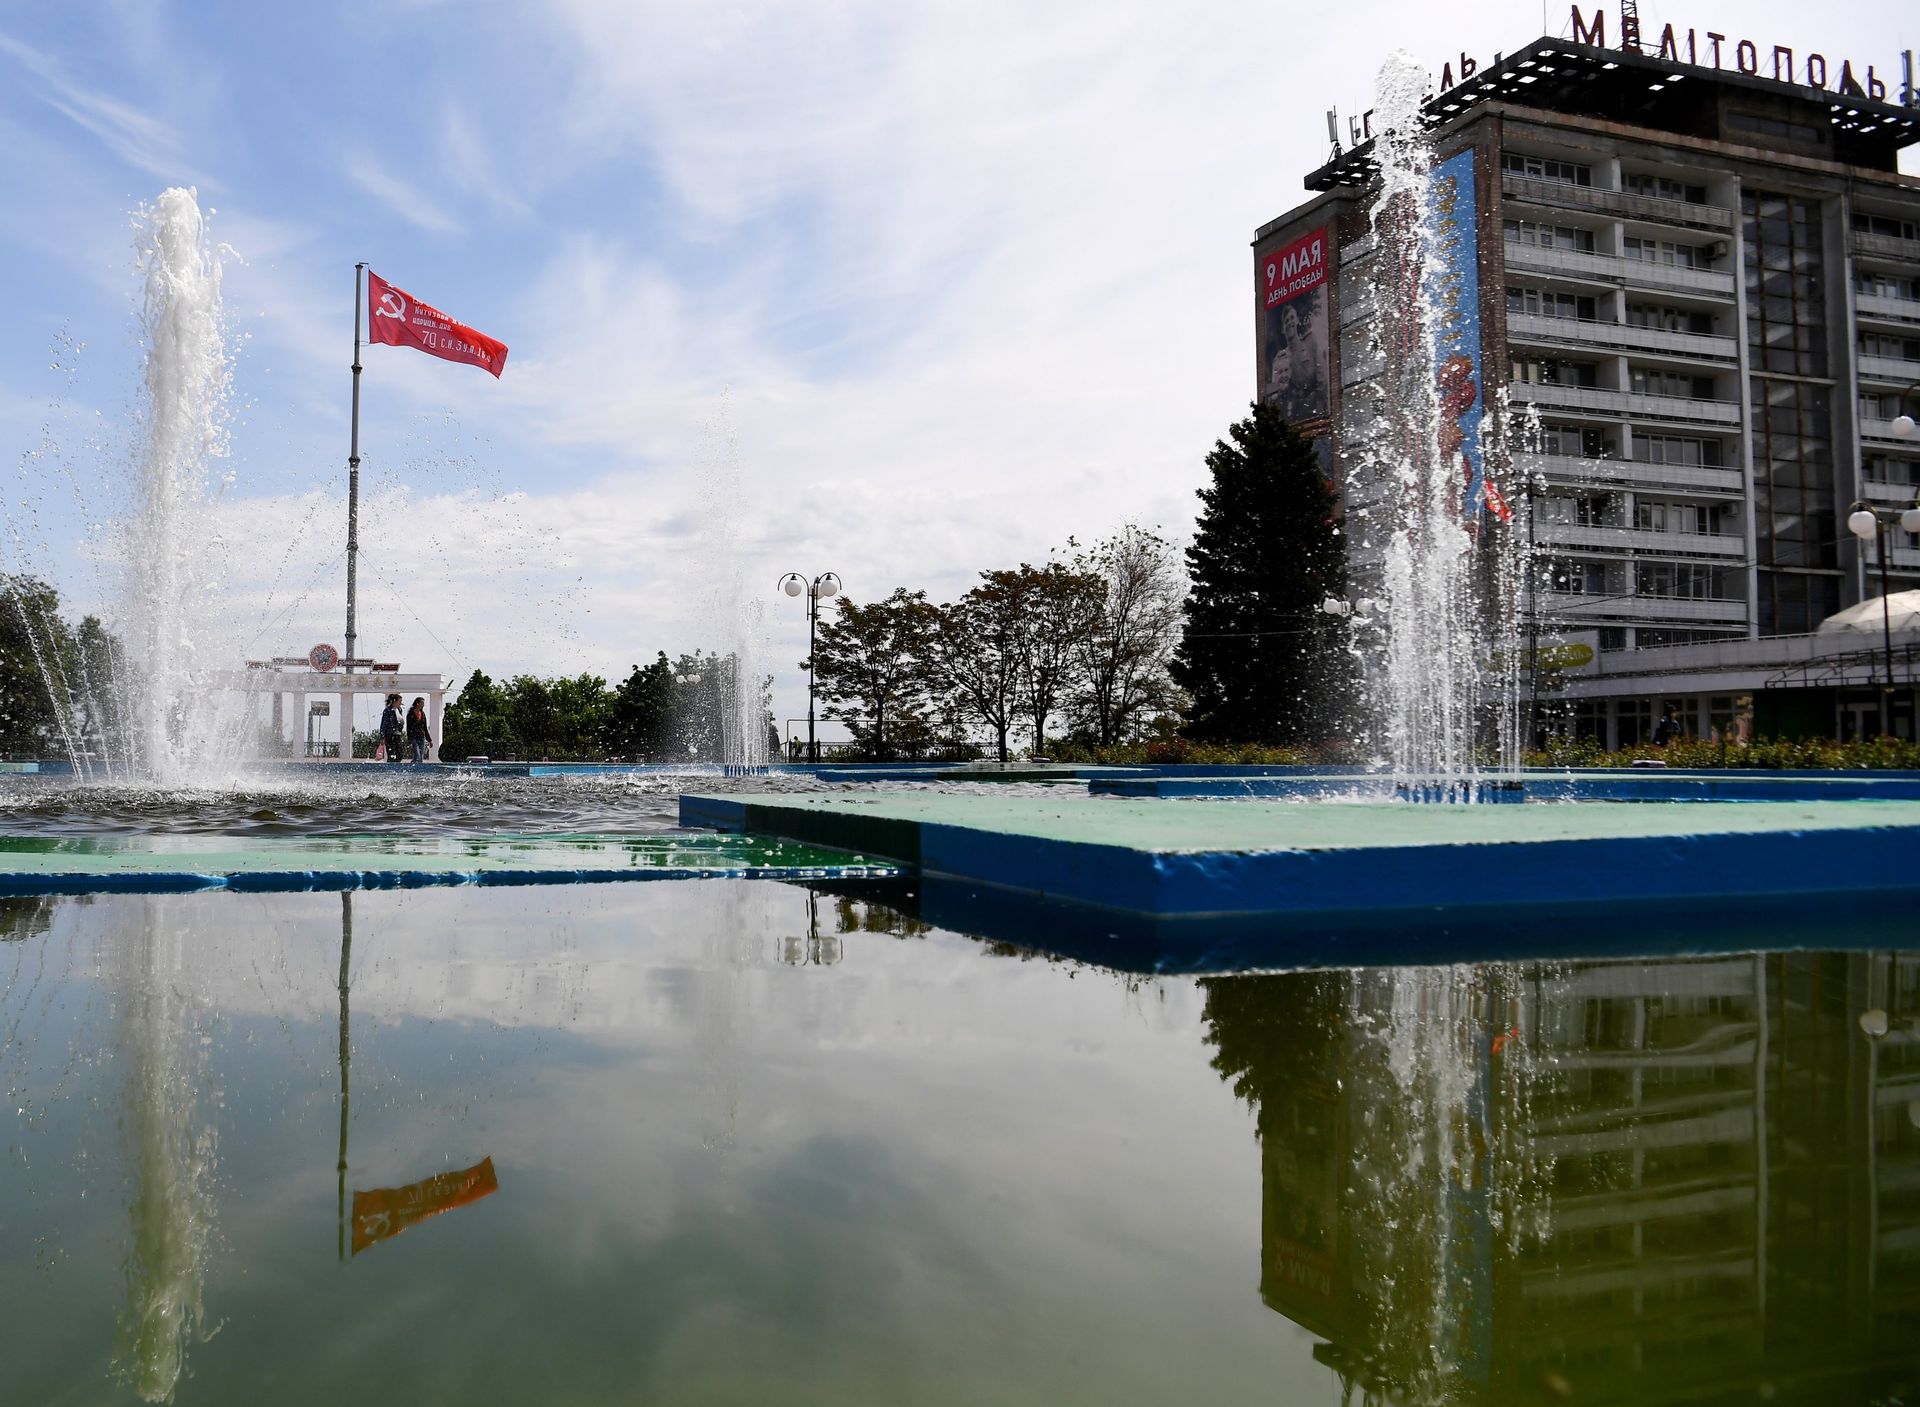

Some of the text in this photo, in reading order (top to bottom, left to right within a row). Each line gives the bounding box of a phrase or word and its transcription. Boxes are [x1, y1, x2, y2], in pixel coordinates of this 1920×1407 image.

[1267, 239, 1321, 287] 9 МАЯ
[1268, 267, 1323, 305] ДЕНЬ ПОБЕДЫ
[422, 331, 436, 348] 79
